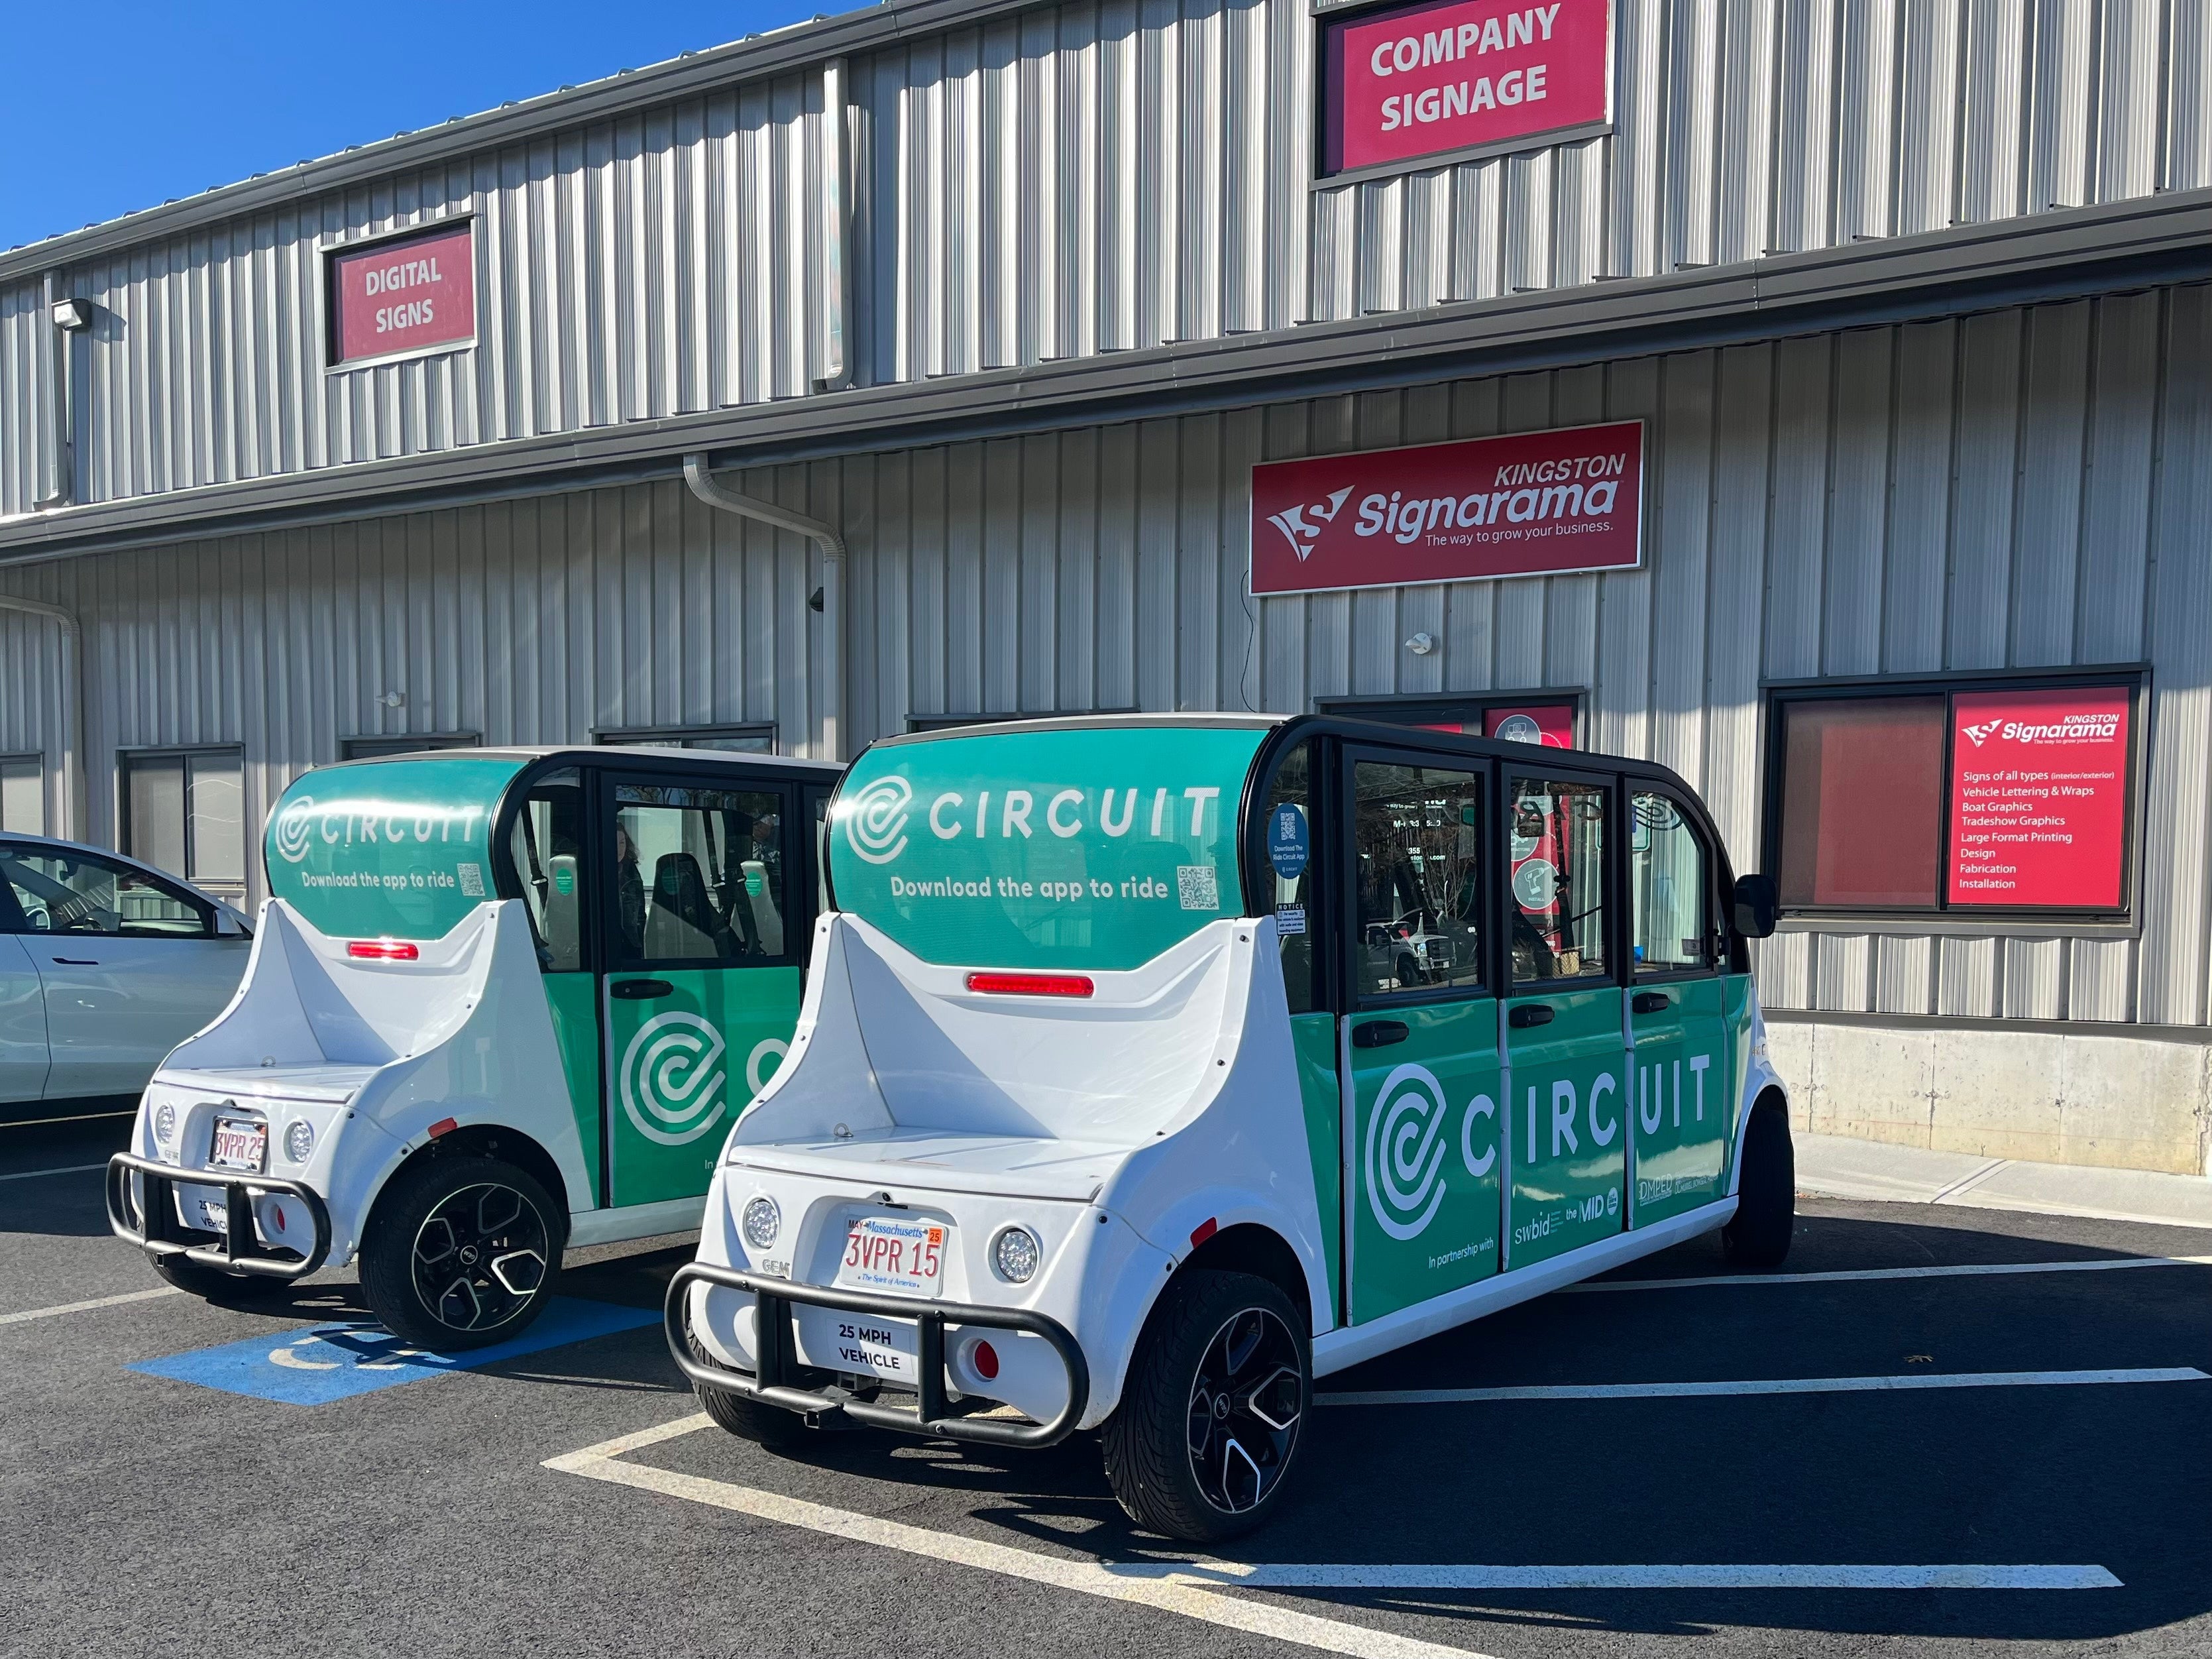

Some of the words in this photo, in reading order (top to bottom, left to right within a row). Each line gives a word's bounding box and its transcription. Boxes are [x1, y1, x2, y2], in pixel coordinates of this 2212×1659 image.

[1370, 3, 1561, 77] COMPANY
[1380, 64, 1547, 131] SIGNAGE
[366, 257, 442, 296] DIGITAL
[376, 299, 433, 333] SIGNS
[1494, 453, 1626, 487] KINGSTON
[1354, 480, 1619, 544] Signarama
[1425, 534, 1447, 547] The
[1449, 534, 1473, 547] way
[1476, 531, 1489, 543] to
[1491, 530, 1522, 544] grow
[1525, 526, 1553, 541] your
[1555, 521, 1613, 536] business.
[2063, 714, 2120, 724] KINGSTON
[2001, 722, 2117, 743] Signarama
[1963, 771, 1991, 783] Signs
[1993, 771, 2005, 781] of
[2005, 770, 2018, 781] all
[2020, 771, 2049, 782] types
[2051, 772, 2115, 781] (interior/exterior)
[1963, 787, 1999, 797] Vehicle
[2001, 787, 2049, 798] Lettering
[2051, 786, 2060, 795] &
[2061, 785, 2095, 797] Wraps
[928, 787, 1220, 840] CIRCUIT
[1962, 802, 1985, 812] Boat
[1987, 801, 2033, 813] Graphics
[321, 806, 484, 844] CIRCUIT
[1961, 816, 2017, 826] Tradeshow
[2019, 815, 2066, 827] Graphics
[1961, 832, 1989, 844] Large
[1991, 832, 2028, 842] Format
[2030, 832, 2073, 844] Printing
[1960, 848, 1996, 860] Design
[1960, 864, 2017, 874] Fabrication
[301, 871, 358, 887] Download
[360, 872, 380, 887] the
[382, 874, 408, 891] app
[410, 873, 424, 888] to
[427, 871, 455, 888] ride
[890, 876, 992, 899] Download
[997, 876, 1033, 898] the
[1039, 882, 1083, 903] app
[1090, 878, 1114, 898] to
[1121, 877, 1169, 899] ride
[1959, 879, 2016, 889] Installation
[1461, 1053, 1711, 1178] CIRCUIT
[215, 1132, 246, 1159] 3VPR
[248, 1136, 265, 1162] 25
[704, 1159, 714, 1170] In
[1639, 1173, 1673, 1200] DMPED
[199, 1200, 207, 1210] 25
[1566, 1208, 1577, 1220] the
[1578, 1194, 1604, 1223] MID
[848, 1220, 863, 1229] MAY
[867, 1221, 922, 1238] Massachusetts
[929, 1231, 940, 1242] 25
[1515, 1211, 1550, 1245] swbid
[846, 1233, 903, 1273] 3VPR
[909, 1241, 940, 1278] 15
[1429, 1256, 1435, 1269] In
[1437, 1242, 1478, 1269] partnership
[1479, 1237, 1494, 1251] with
[762, 1259, 790, 1277] GEM
[873, 1275, 887, 1284] Spirit
[894, 1278, 917, 1288] America
[838, 1324, 855, 1339] 25
[859, 1327, 891, 1345] MPH
[838, 1347, 901, 1369] VEHICLE
